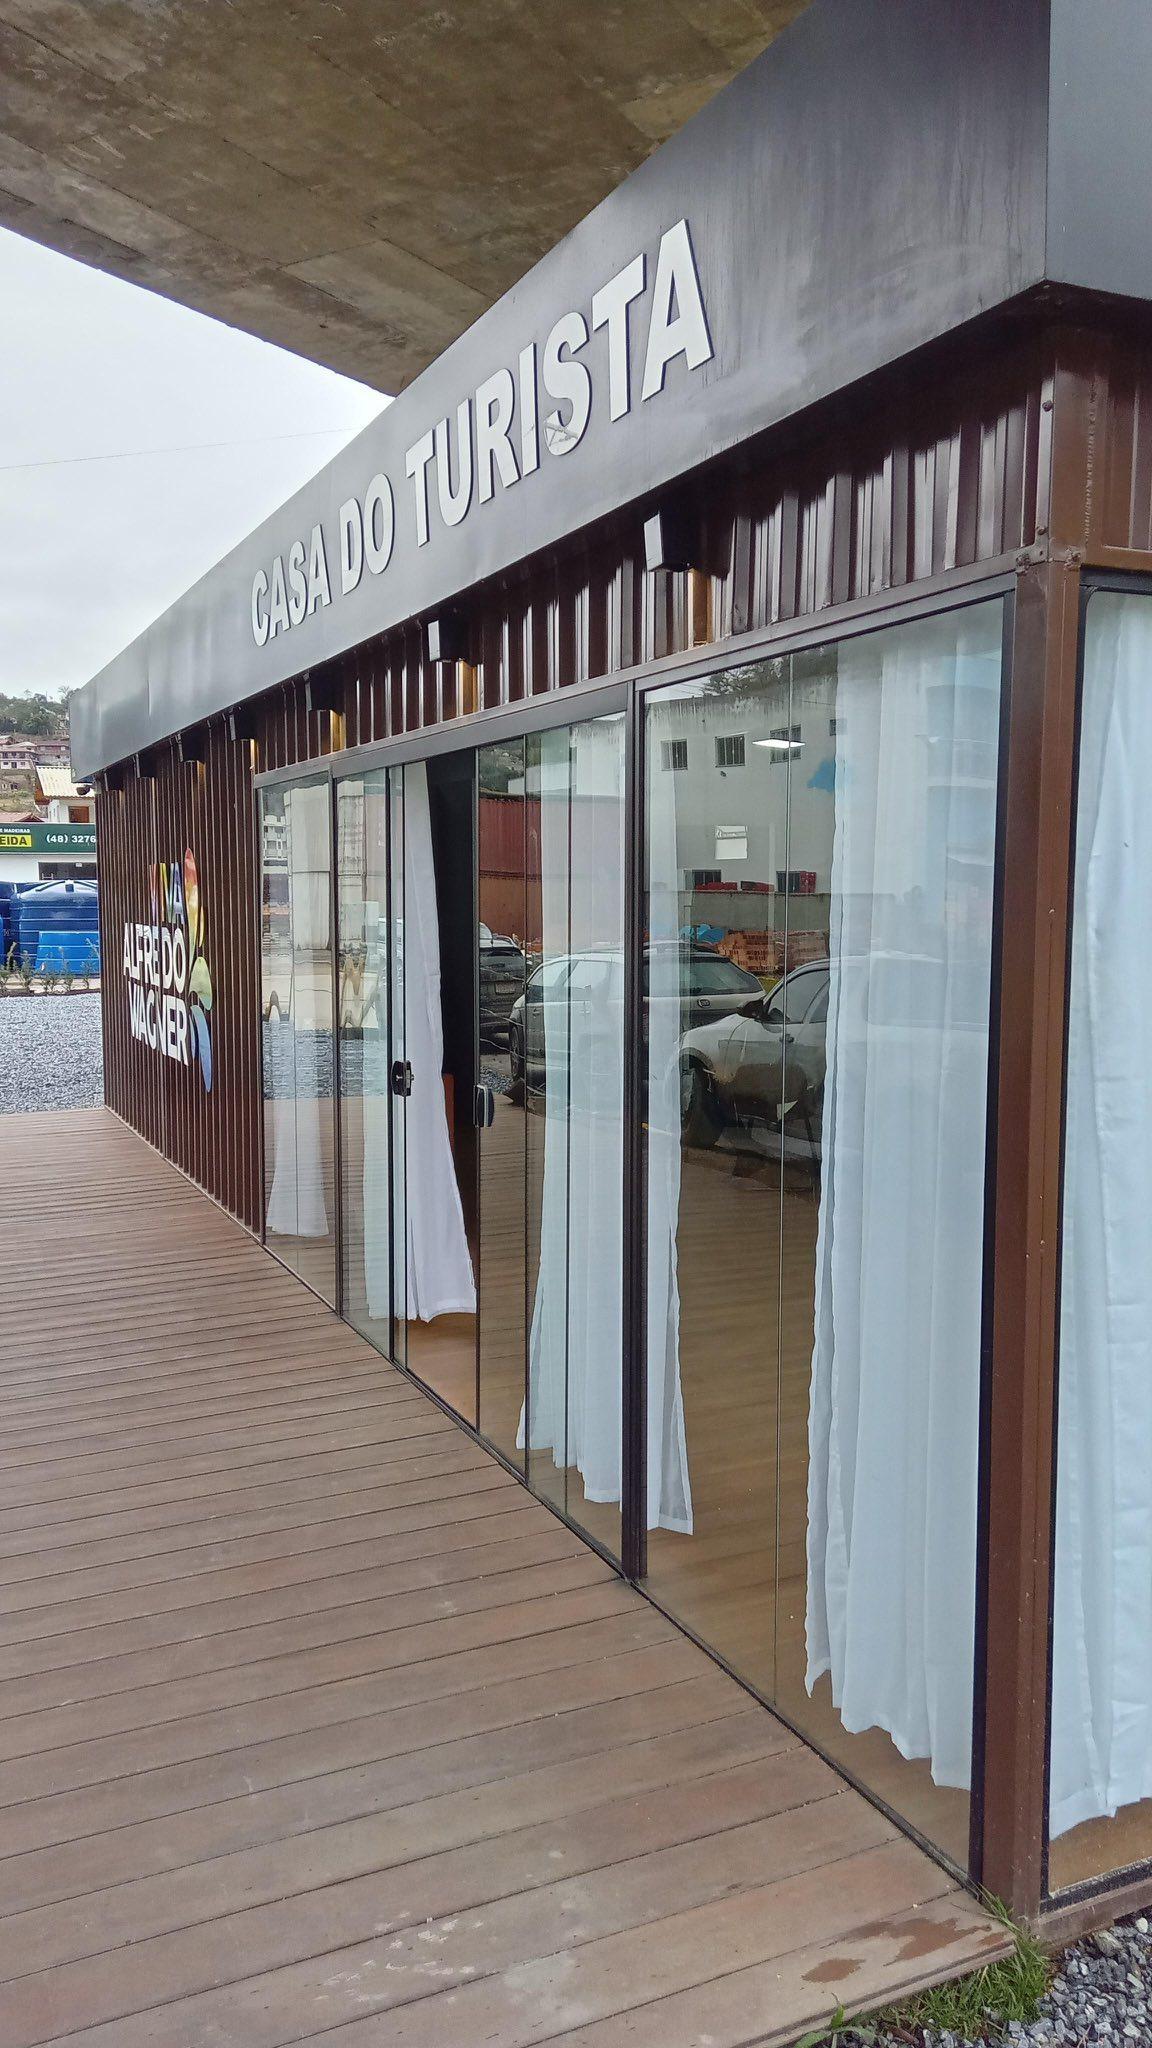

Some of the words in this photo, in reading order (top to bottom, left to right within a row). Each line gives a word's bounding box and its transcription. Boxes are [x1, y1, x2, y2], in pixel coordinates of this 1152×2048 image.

[251, 524, 332, 647] CASA
[339, 473, 395, 596] DO
[405, 217, 715, 549] TURISTA
[46, 834, 68, 843] (48)
[123, 922, 187, 994] ALFREDO
[128, 980, 189, 1066] WAGNER
